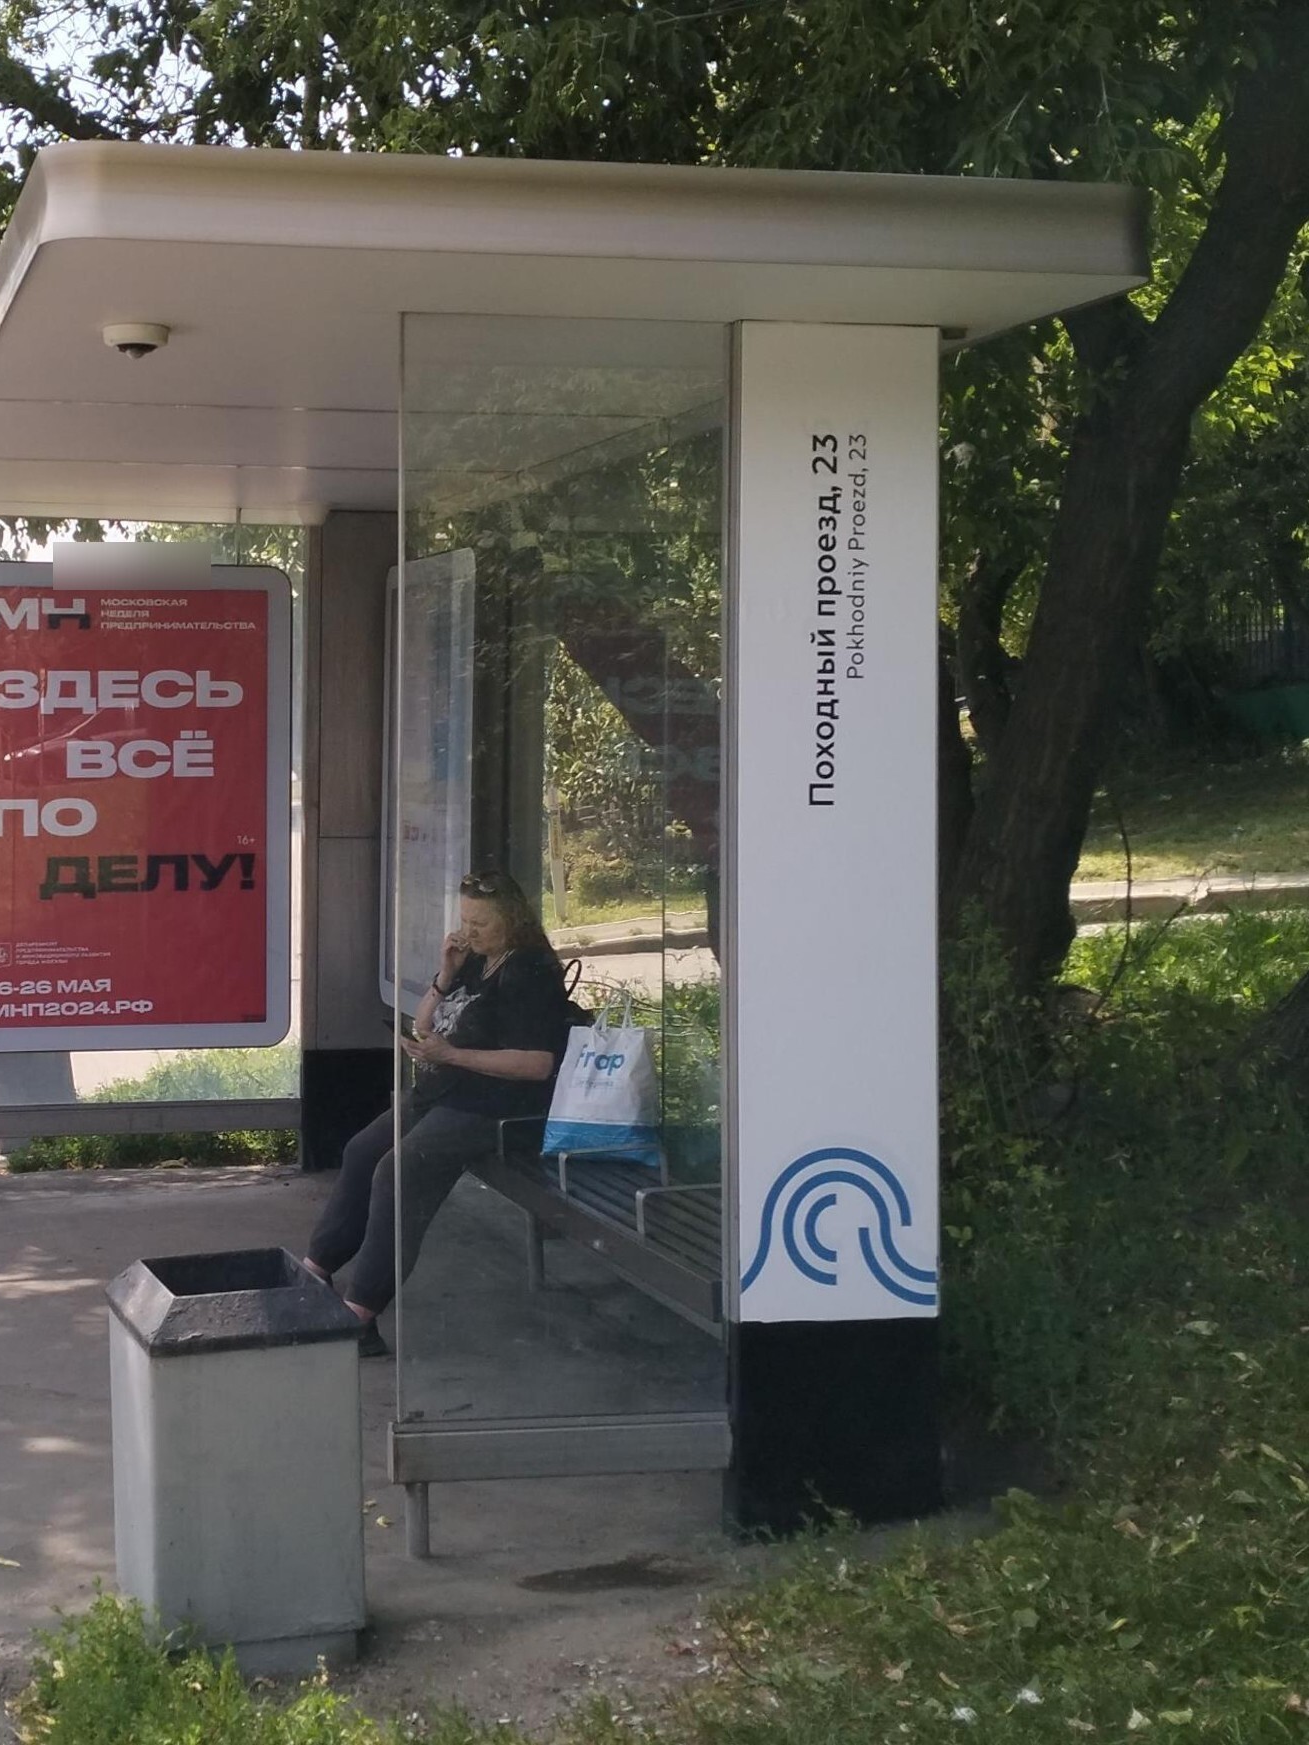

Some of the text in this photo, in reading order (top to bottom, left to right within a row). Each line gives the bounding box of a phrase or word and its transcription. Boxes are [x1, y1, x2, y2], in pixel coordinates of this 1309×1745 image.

[846, 433, 869, 679] Pokhodniy Proezd, 23
[100, 598, 189, 607] МОСКОВСКАЯ
[100, 609, 151, 618] НЕДЕЛЯ
[809, 434, 842, 806] Походный проезд, 23
[100, 621, 256, 630] ПРЕДПРИНИМАТЕЛЬСТВА
[66, 730, 214, 778] ВСЁ
[236, 834, 255, 846] 16+
[39, 853, 256, 900] ДЕЛУ!
[57, 979, 111, 993] МАЯ
